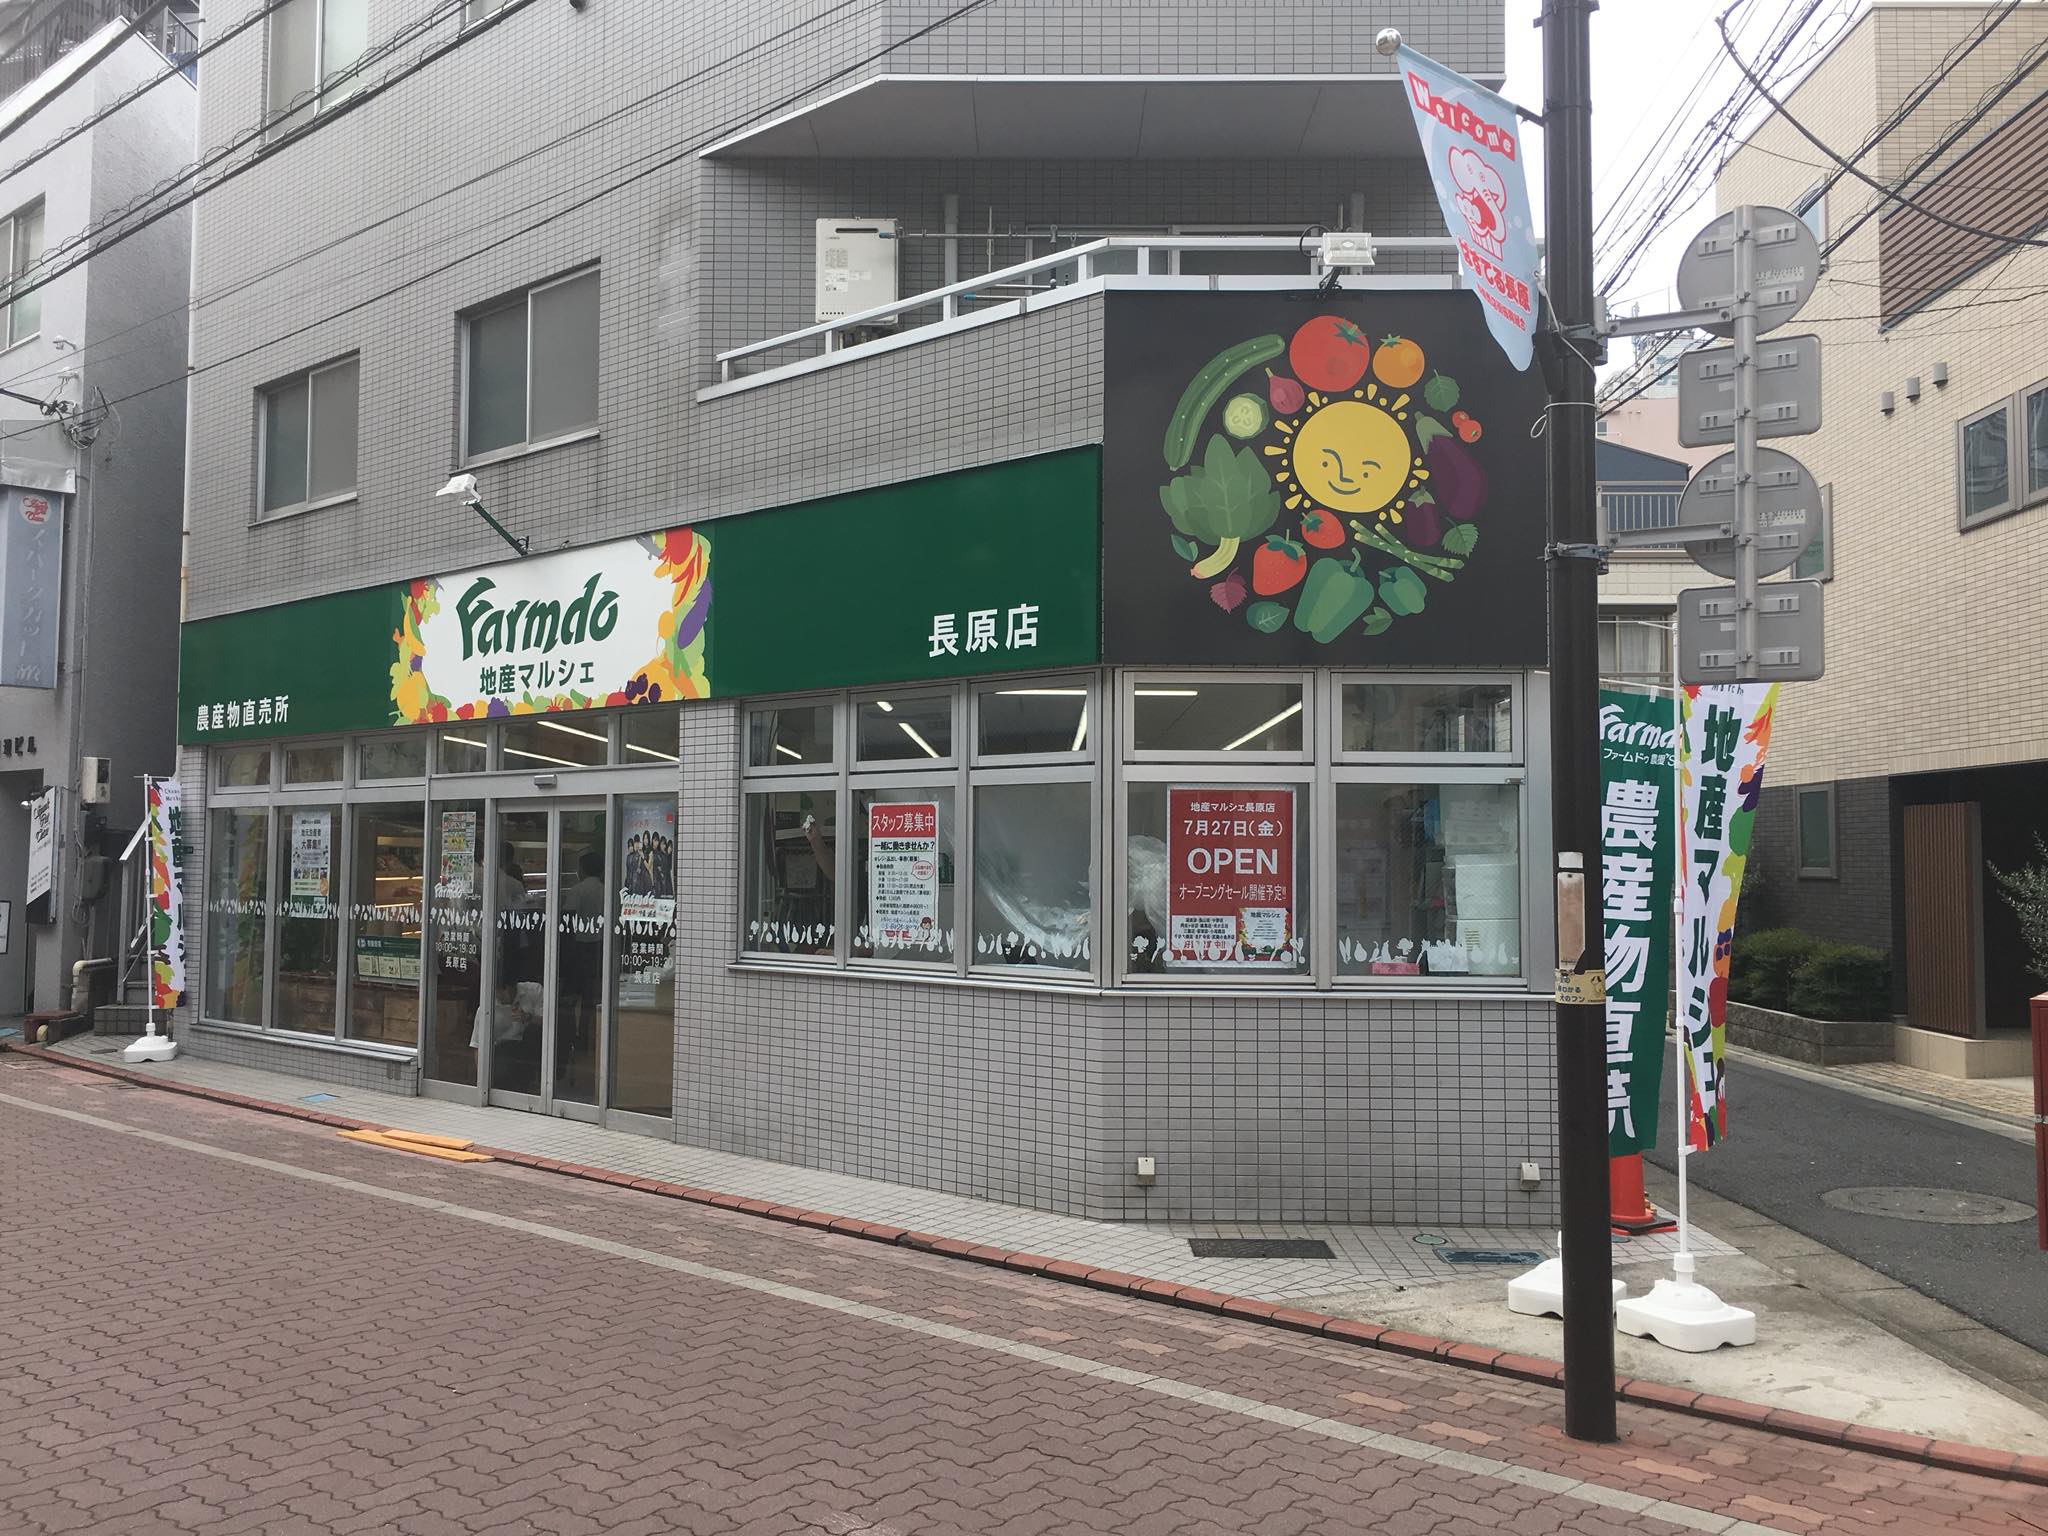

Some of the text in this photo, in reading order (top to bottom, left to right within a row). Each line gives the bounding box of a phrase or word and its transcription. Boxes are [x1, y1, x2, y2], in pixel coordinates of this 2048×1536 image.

[1411, 77, 1512, 154] Welcome
[456, 572, 620, 661] Farmdo
[928, 603, 1040, 658] 長原店
[480, 658, 595, 696] 地産マルシェ
[196, 695, 289, 731] 農産物直売所
[1191, 802, 1276, 813] 地産マルシェ長原店
[872, 812, 934, 833] スタッフ募集中
[1187, 848, 1278, 875] OPEN
[619, 887, 656, 905] Farmdo
[1688, 704, 1742, 1092] 地産マルシェ
[443, 931, 470, 942] 営業時間
[631, 942, 664, 955] 営業時間
[445, 957, 468, 969] 長原店
[633, 971, 661, 984] 長原店
